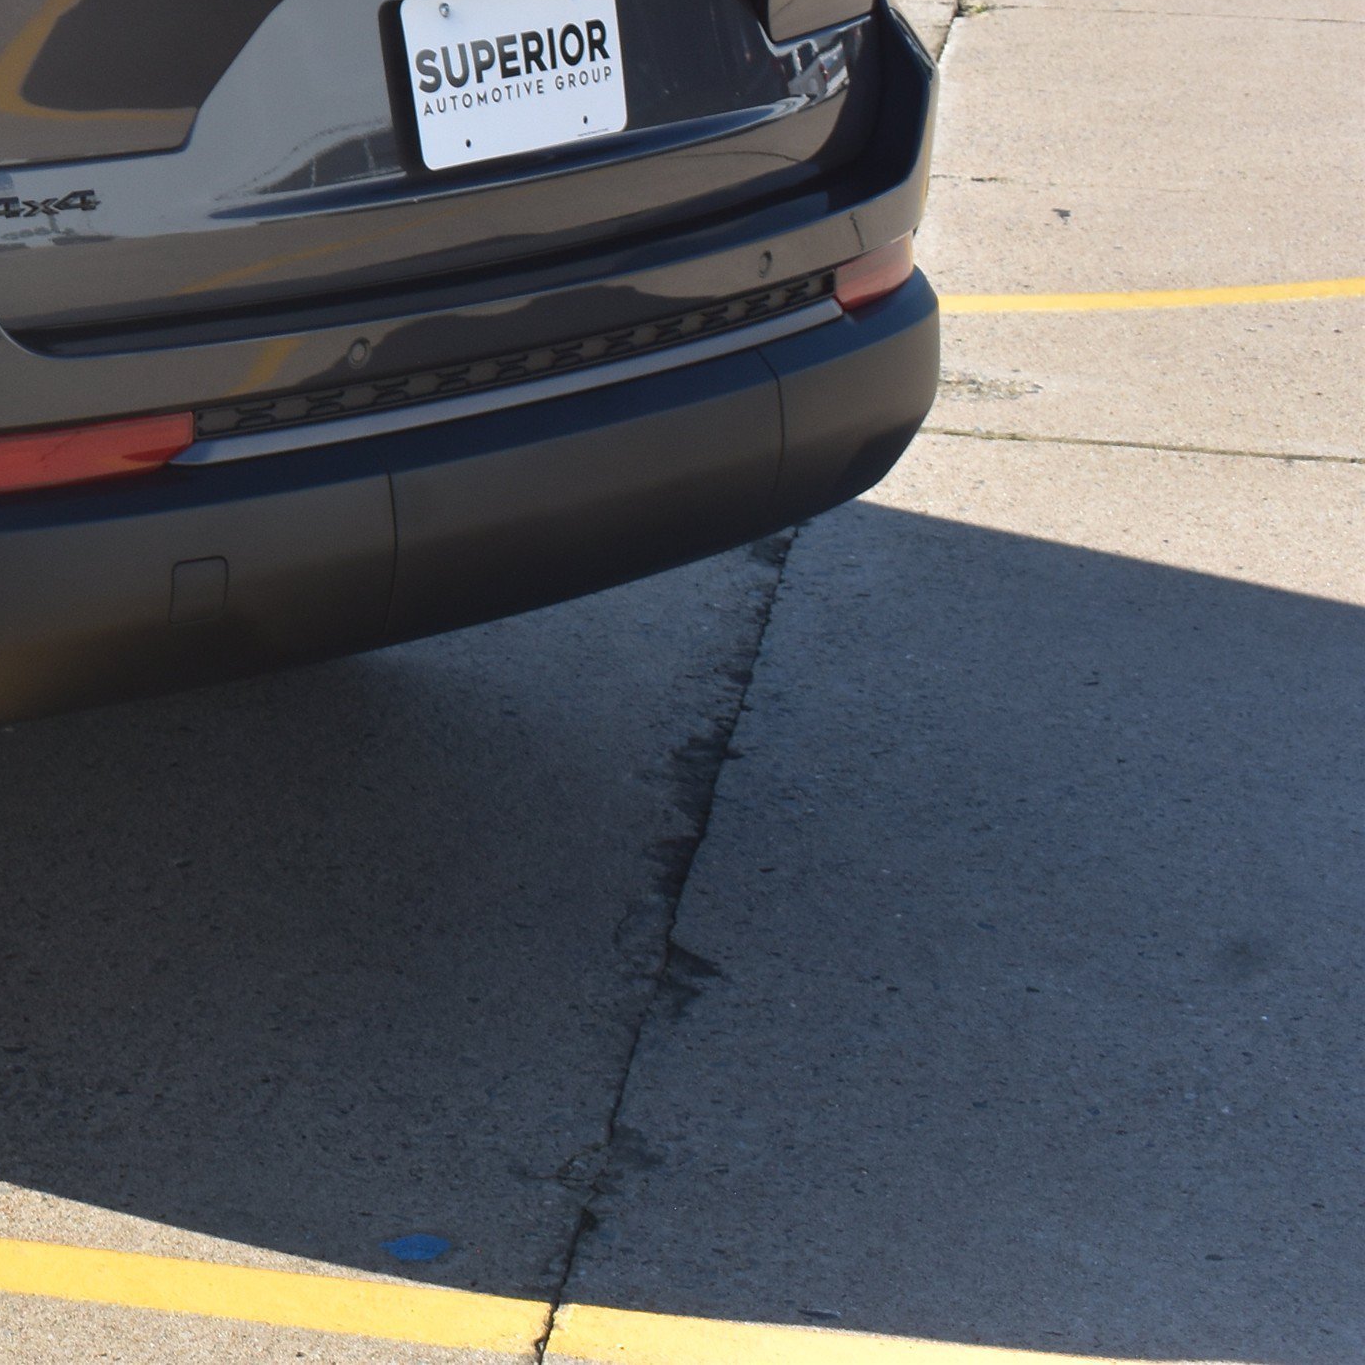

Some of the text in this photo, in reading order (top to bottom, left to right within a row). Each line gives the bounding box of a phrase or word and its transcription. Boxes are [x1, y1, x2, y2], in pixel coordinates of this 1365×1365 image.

[416, 19, 610, 93] SUPERIOR
[423, 65, 612, 116] AUTOMOTIVE GROUP
